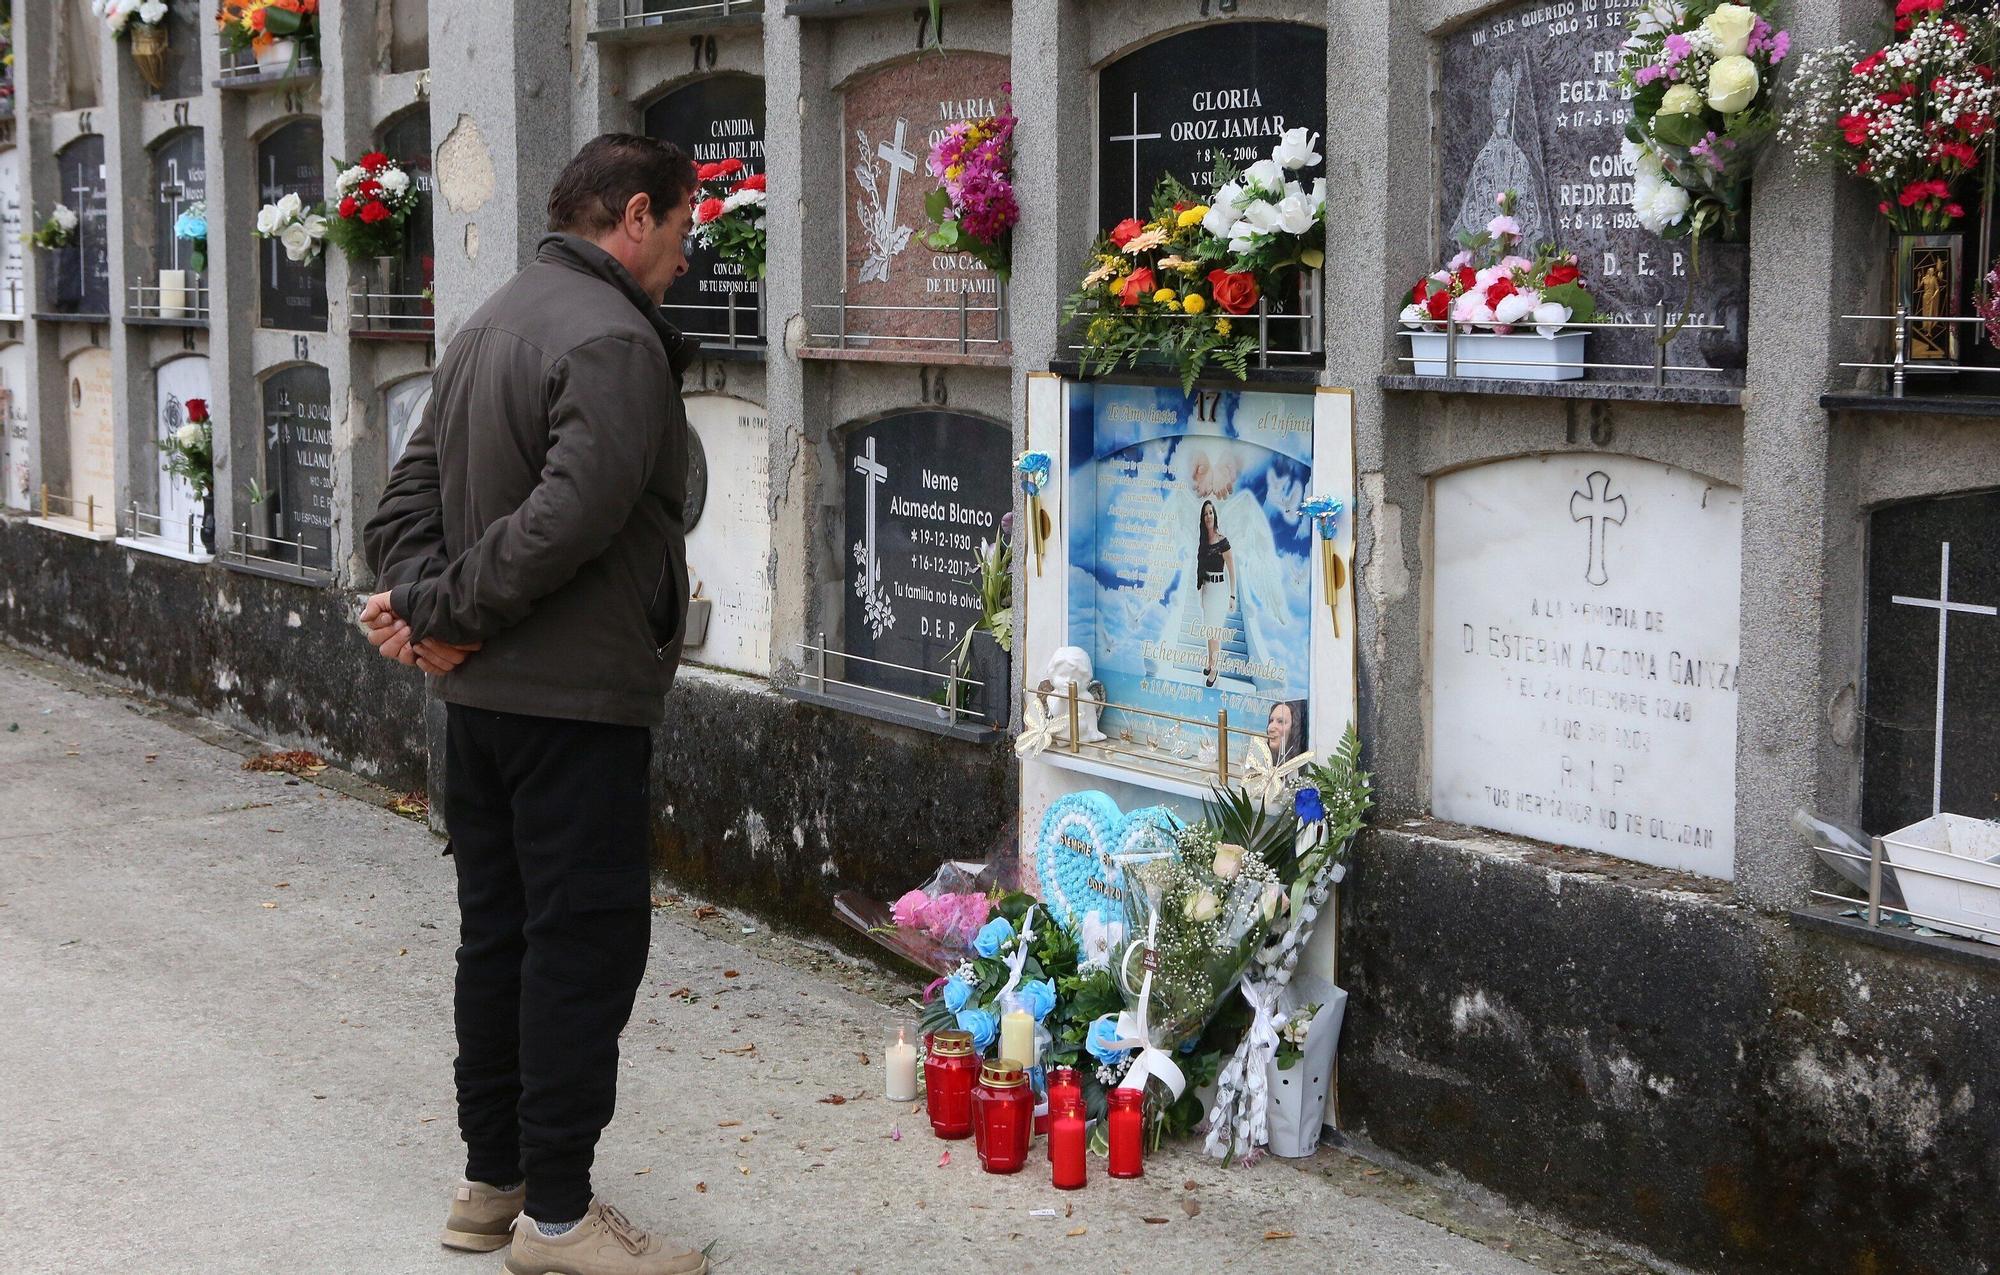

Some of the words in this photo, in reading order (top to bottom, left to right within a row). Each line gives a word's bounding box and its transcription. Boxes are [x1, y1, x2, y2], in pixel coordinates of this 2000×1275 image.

[1492, 20, 1515, 38] SER
[1548, 18, 1579, 38] SOLO
[1606, 12, 1621, 27] SE
[1192, 88, 1262, 112] GLORIA
[1559, 80, 1609, 104] EGEA
[939, 97, 997, 120] MARIA
[711, 118, 755, 138] CANDIDA
[1170, 119, 1219, 142] OROZ
[1222, 115, 1286, 139] JAMAR
[694, 142, 727, 160] MARIA
[729, 141, 748, 159] DEL
[750, 140, 765, 158] PIN
[1233, 145, 1258, 161] 2006
[1589, 154, 1637, 178] CONC
[1191, 172, 1200, 186] Y
[1560, 182, 1634, 206] REDRAD
[713, 263, 728, 276] CON
[933, 255, 957, 271] CON
[1603, 252, 1622, 276] D.
[1638, 252, 1655, 276] E.
[1672, 252, 1686, 276] P.
[699, 279, 708, 292] DE
[709, 280, 718, 292] TU
[719, 280, 744, 293] ESPOSO
[926, 278, 941, 293] DE
[943, 278, 959, 293] TU
[294, 334, 309, 360] 13
[307, 403, 331, 422] JOAQ
[1193, 390, 1222, 423] 17
[296, 425, 332, 446] VILLANUE
[1271, 410, 1313, 440] Infinit
[296, 449, 331, 469] VILLANU
[922, 468, 959, 492] Neme
[889, 495, 945, 521] Alameda
[949, 502, 993, 527] Blanco
[920, 528, 971, 551] 19-12-1930
[919, 554, 970, 577] 16-12-2017
[893, 581, 903, 597] Tu
[904, 583, 934, 602] familia
[936, 591, 947, 604] no
[949, 590, 958, 606] te
[959, 593, 983, 610] olvid
[921, 616, 932, 637] D.
[935, 618, 945, 639] E.
[948, 621, 958, 642] P.
[1189, 616, 1239, 642] Leonor
[1645, 610, 1664, 633] DE
[1060, 831, 1093, 859] SIEMPRE
